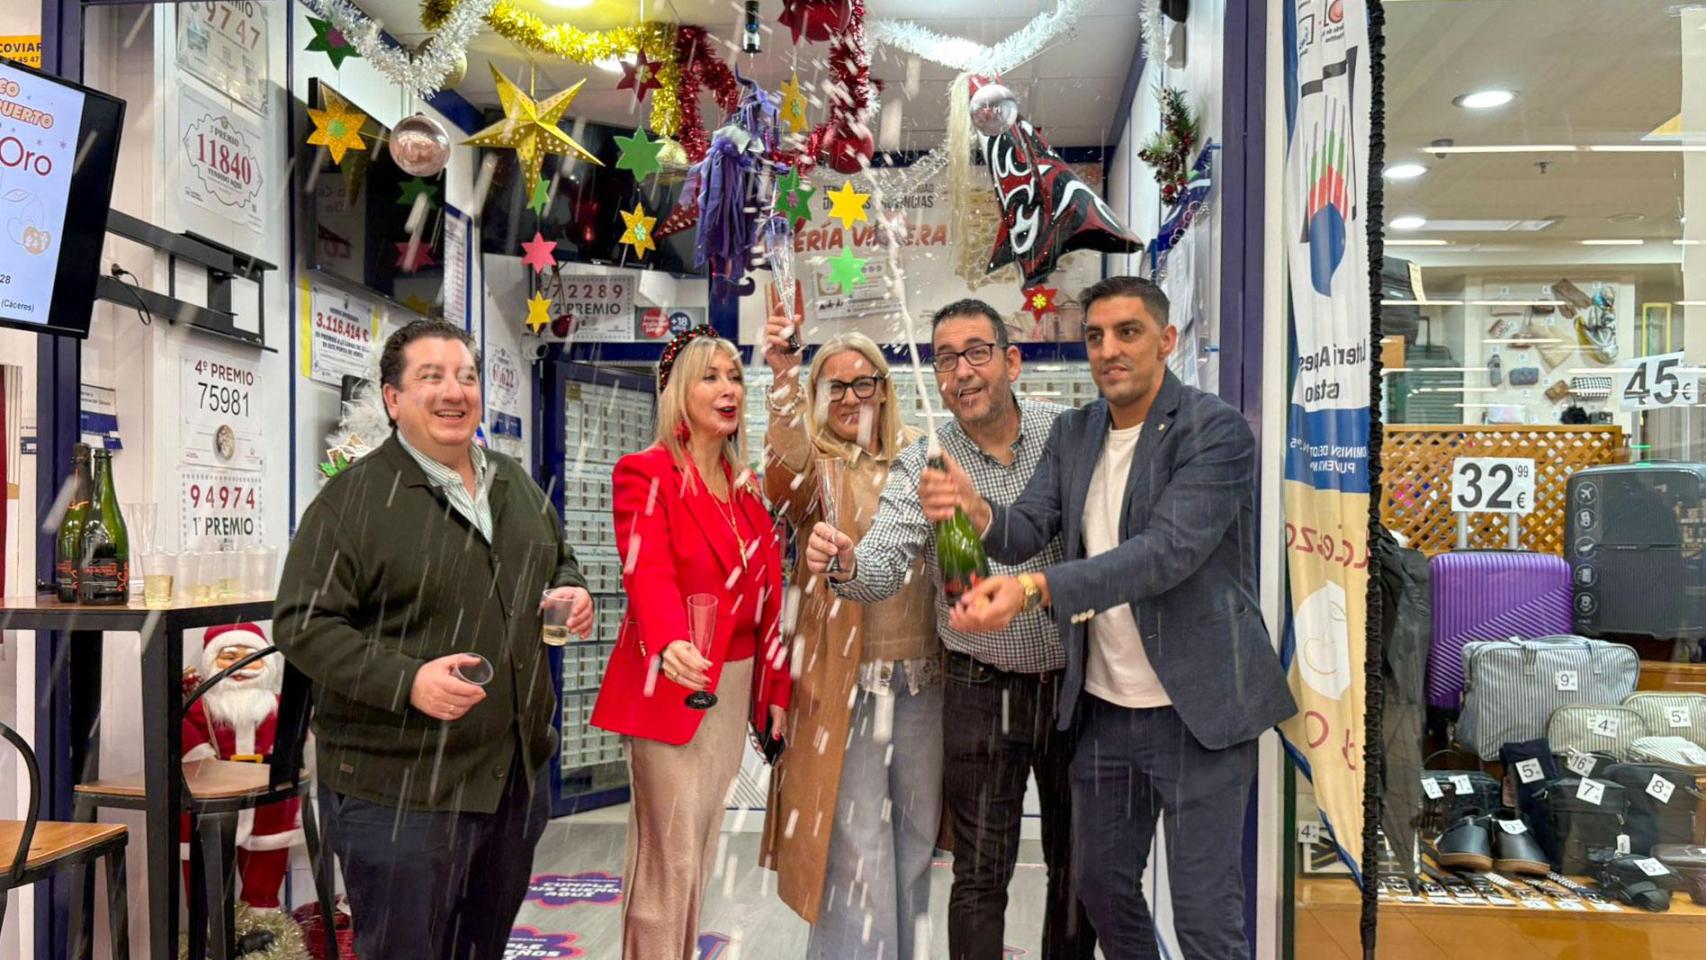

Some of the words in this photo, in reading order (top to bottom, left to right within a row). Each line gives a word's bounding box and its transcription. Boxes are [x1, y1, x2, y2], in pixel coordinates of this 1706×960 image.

[0, 99, 54, 129] UERTO
[0, 136, 52, 176] Oro
[197, 133, 252, 185] 11840
[552, 284, 624, 299] 72289
[566, 303, 622, 316] PREMIO
[211, 363, 254, 386] PREMIO
[1624, 358, 1679, 405] 45
[197, 381, 249, 418] 75981
[1457, 462, 1513, 509] 32
[1517, 491, 1526, 509] €
[190, 484, 256, 510] 94974
[204, 516, 254, 537] PREMIO
[1560, 673, 1570, 687] 9
[1597, 719, 1609, 733] 4
[1671, 710, 1682, 724] 5
[1521, 763, 1535, 779] 5
[1583, 782, 1595, 796] 7
[1651, 779, 1665, 794] 8
[1301, 824, 1311, 839] 4
